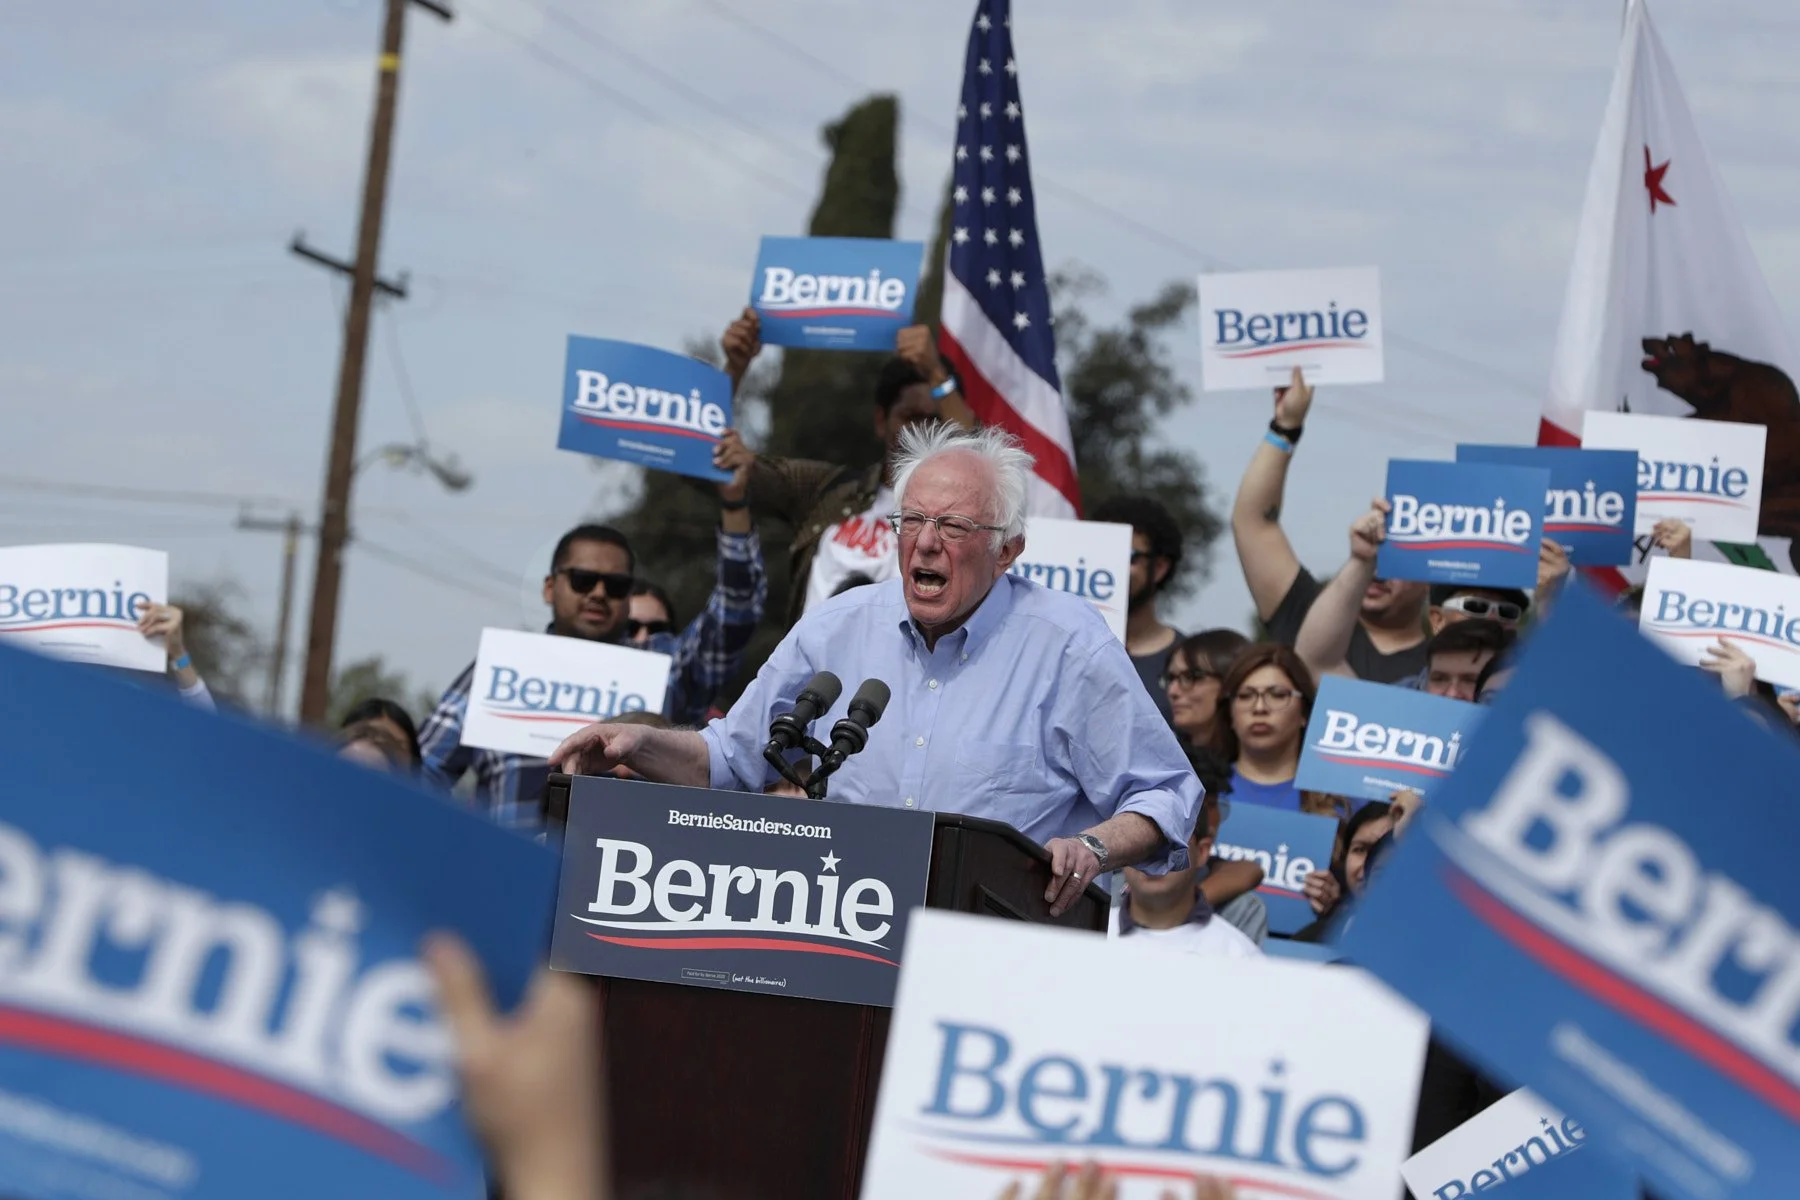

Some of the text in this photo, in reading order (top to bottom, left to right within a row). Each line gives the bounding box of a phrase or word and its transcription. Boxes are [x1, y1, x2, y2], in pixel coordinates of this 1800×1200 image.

[760, 267, 906, 308] Bernie
[1214, 300, 1369, 345] Bernie
[575, 369, 727, 435] Bernie
[1389, 494, 1532, 544] Bernie
[1013, 557, 1116, 600] rnie
[1318, 709, 1466, 771] Berni
[668, 809, 832, 839] BernieSanders.com
[588, 838, 894, 942] Bernie
[1209, 843, 1315, 892] rnie
[920, 1021, 1368, 1180] Bernie
